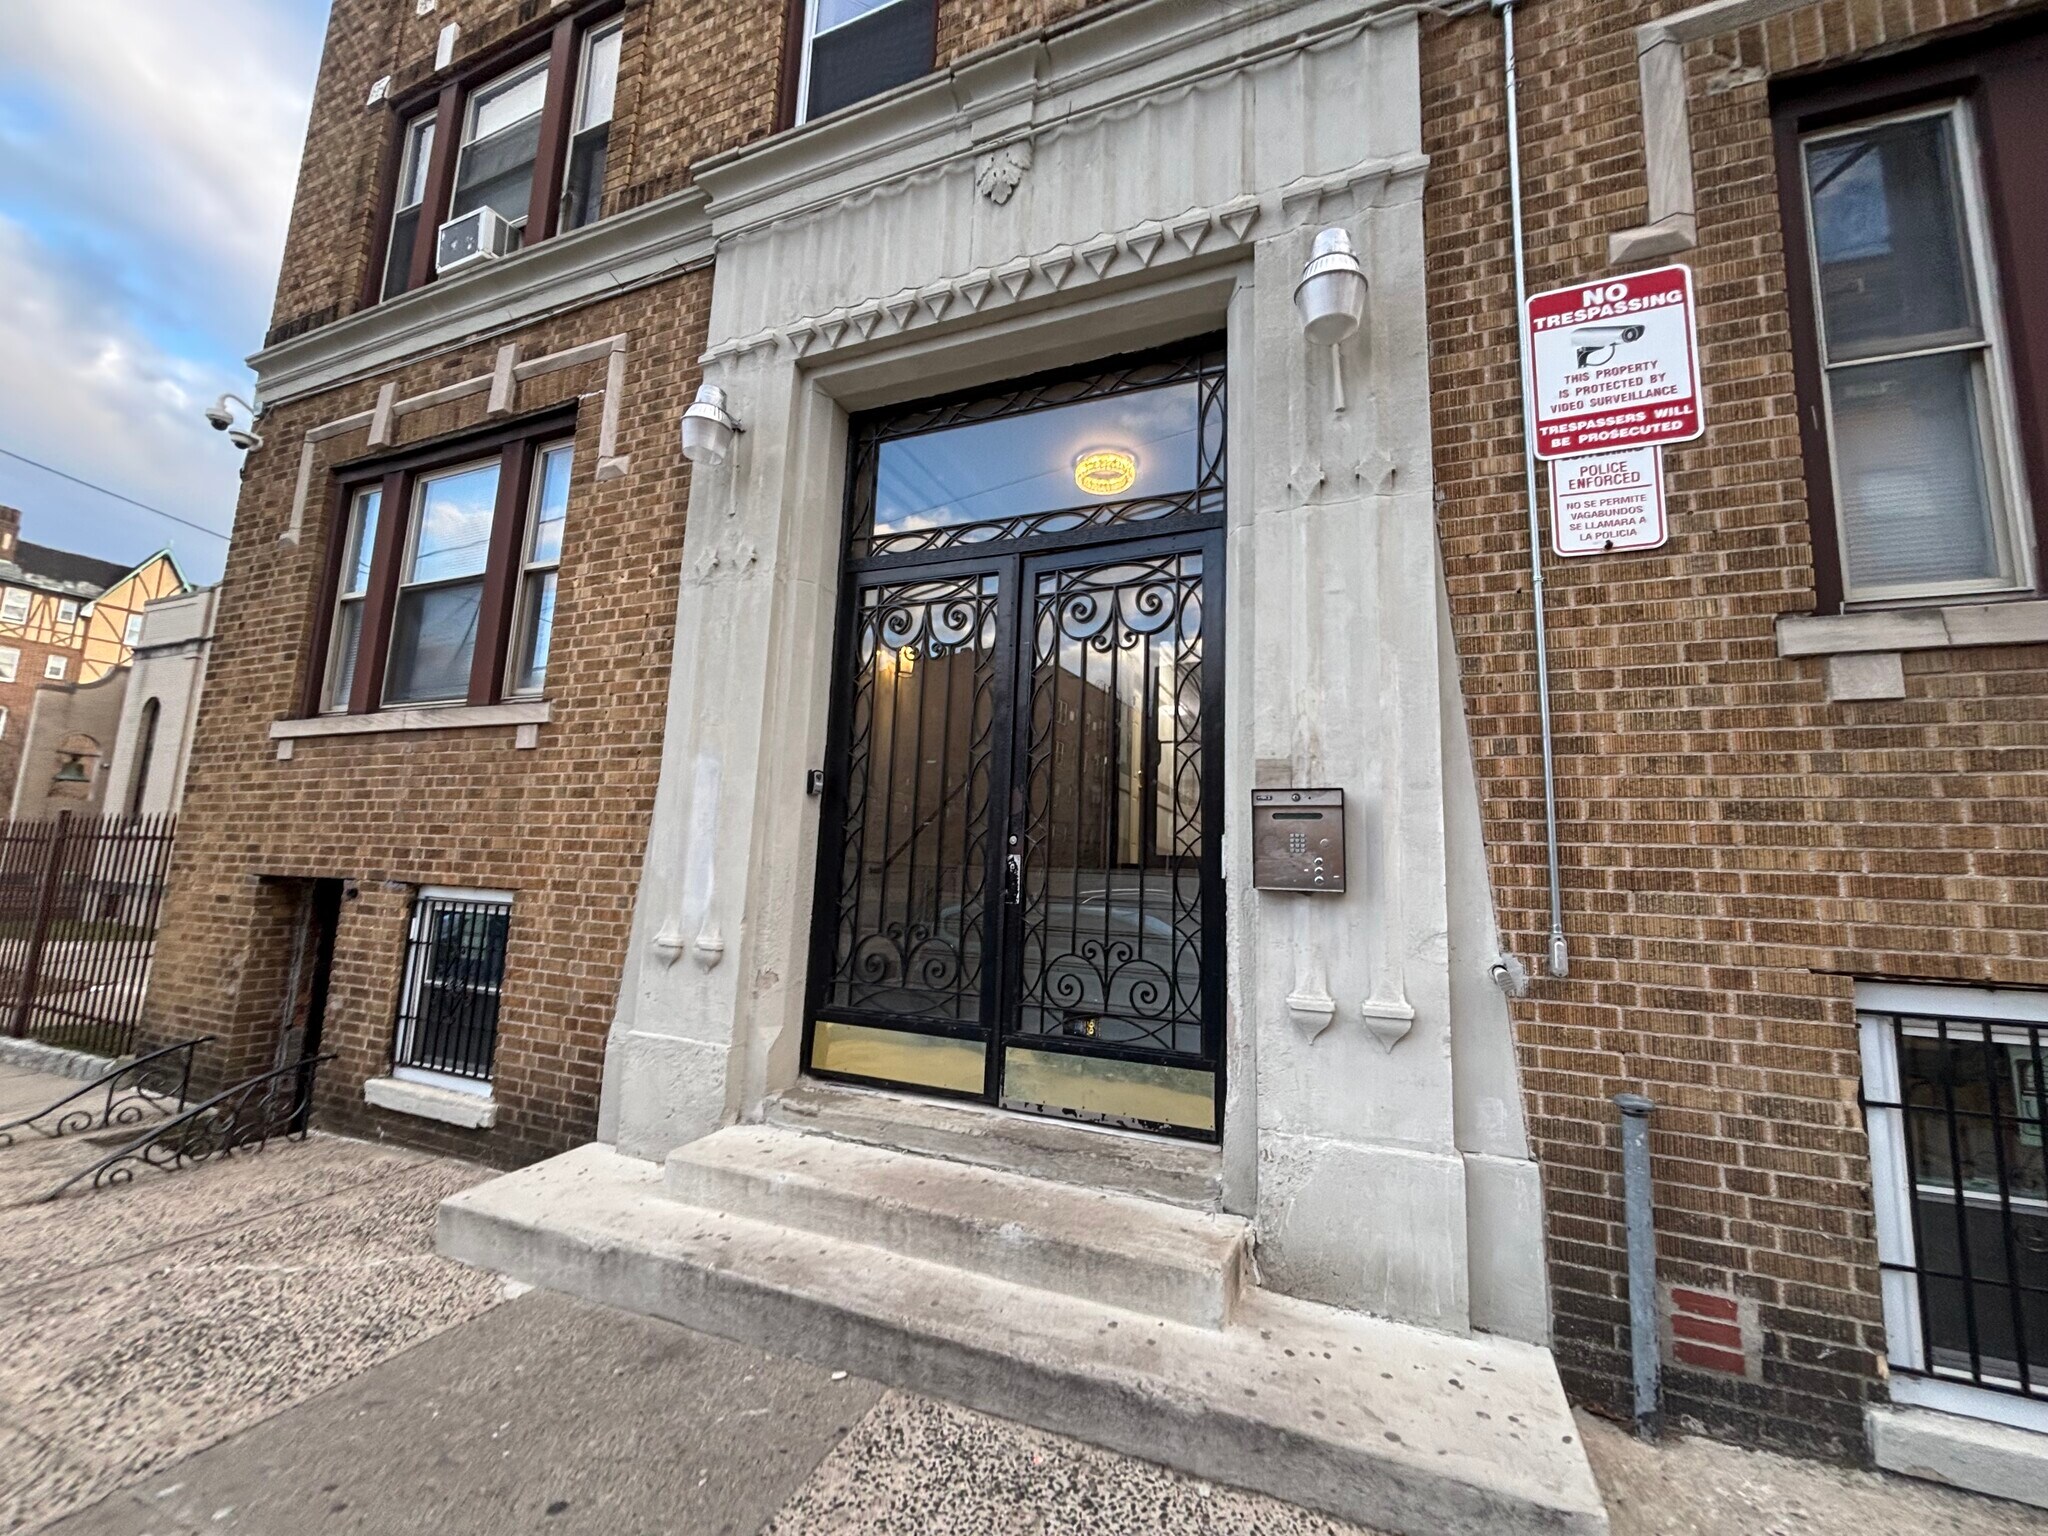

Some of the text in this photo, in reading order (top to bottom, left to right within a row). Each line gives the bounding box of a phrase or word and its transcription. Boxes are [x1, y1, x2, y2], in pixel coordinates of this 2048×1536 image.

[1583, 283, 1628, 307] NO
[1533, 290, 1682, 330] TRESPASSING
[1564, 360, 1658, 384] THIS PROPERTY
[1559, 373, 1666, 398] IS PROTECTED BY
[1550, 385, 1678, 413] VIDEO SURVEILLANCE
[1540, 405, 1693, 436] TRESPASSERS WILL
[1551, 421, 1683, 448] BE PROSECUTED
[1568, 472, 1640, 490] ENFORCED
[1580, 461, 1628, 477] POLICE
[1567, 494, 1646, 510] NO SE PERMITE
[1571, 506, 1643, 520] VAGABUNDOS
[1570, 523, 1582, 531] SE
[1585, 518, 1635, 529] LLAMARA
[1580, 529, 1637, 541] LA POLICIA
